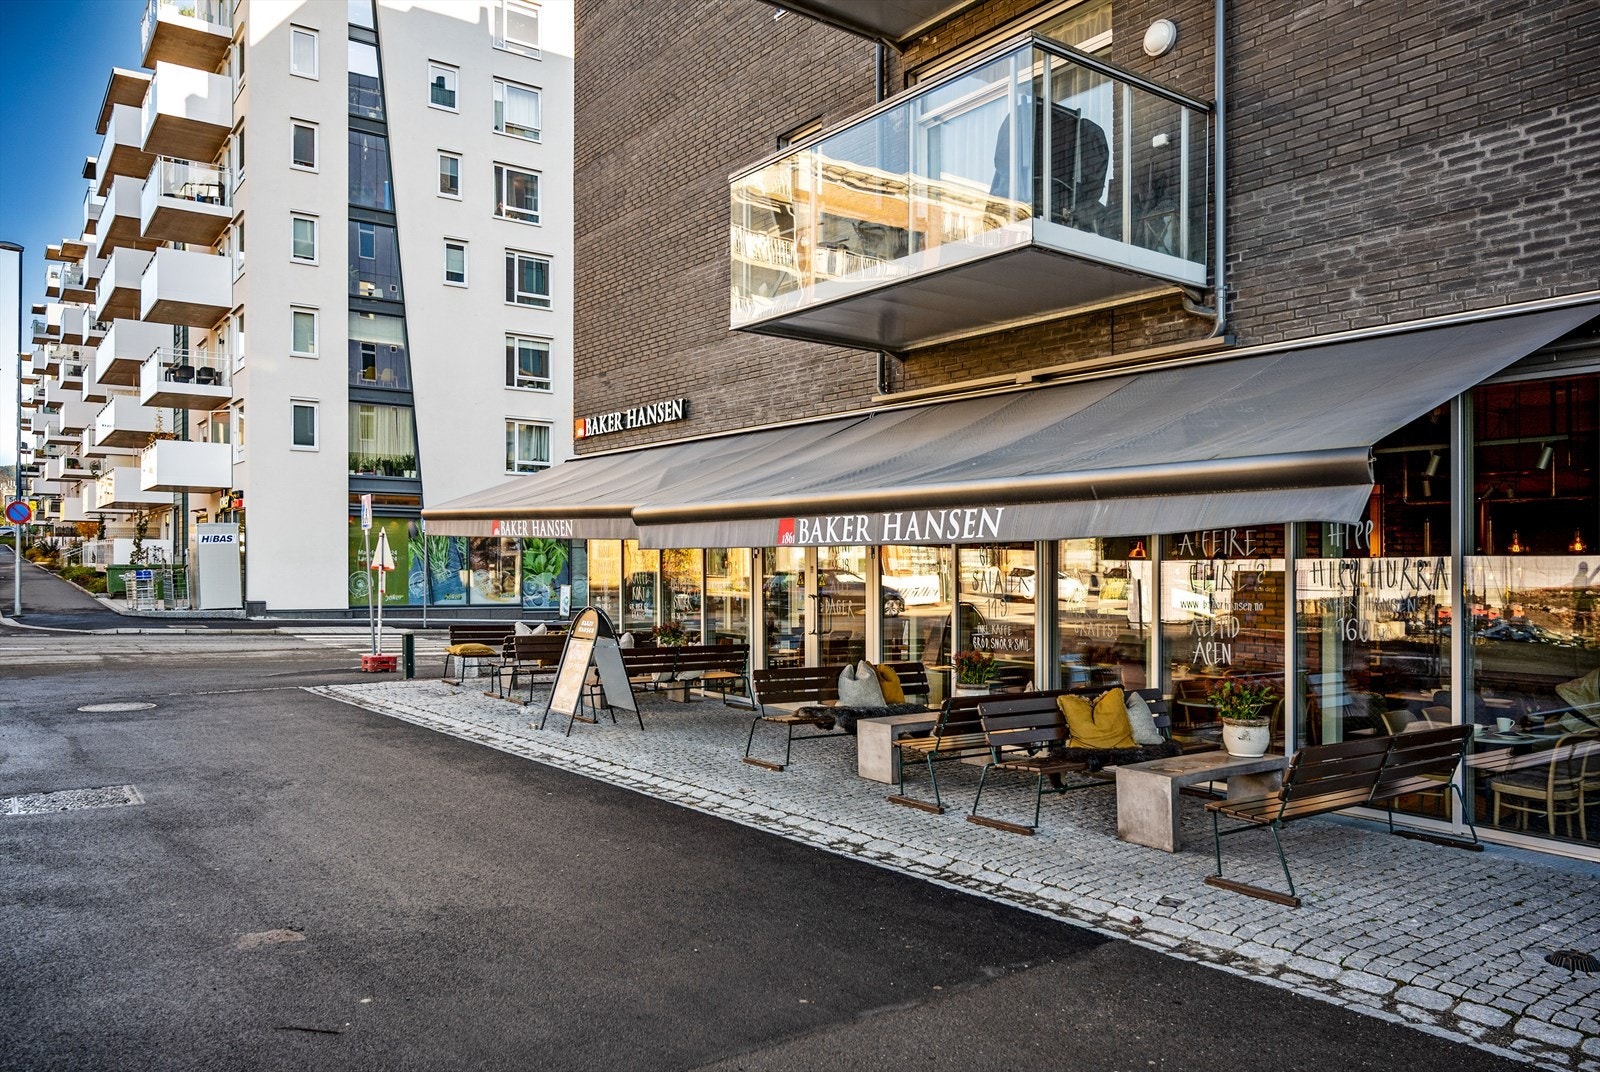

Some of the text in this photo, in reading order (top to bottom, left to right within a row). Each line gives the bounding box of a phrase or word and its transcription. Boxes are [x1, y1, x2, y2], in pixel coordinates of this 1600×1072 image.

[585, 398, 684, 437] BAKER HANSEN
[201, 534, 233, 543] HIBAS
[500, 520, 529, 536] BAKER
[532, 519, 573, 537] HANSEN
[798, 513, 872, 544] BAKER
[881, 507, 1005, 541] HANSEN
[1366, 557, 1449, 591] HURRA
[1335, 617, 1371, 643] 160
[1192, 638, 1232, 666] ÅPEN
